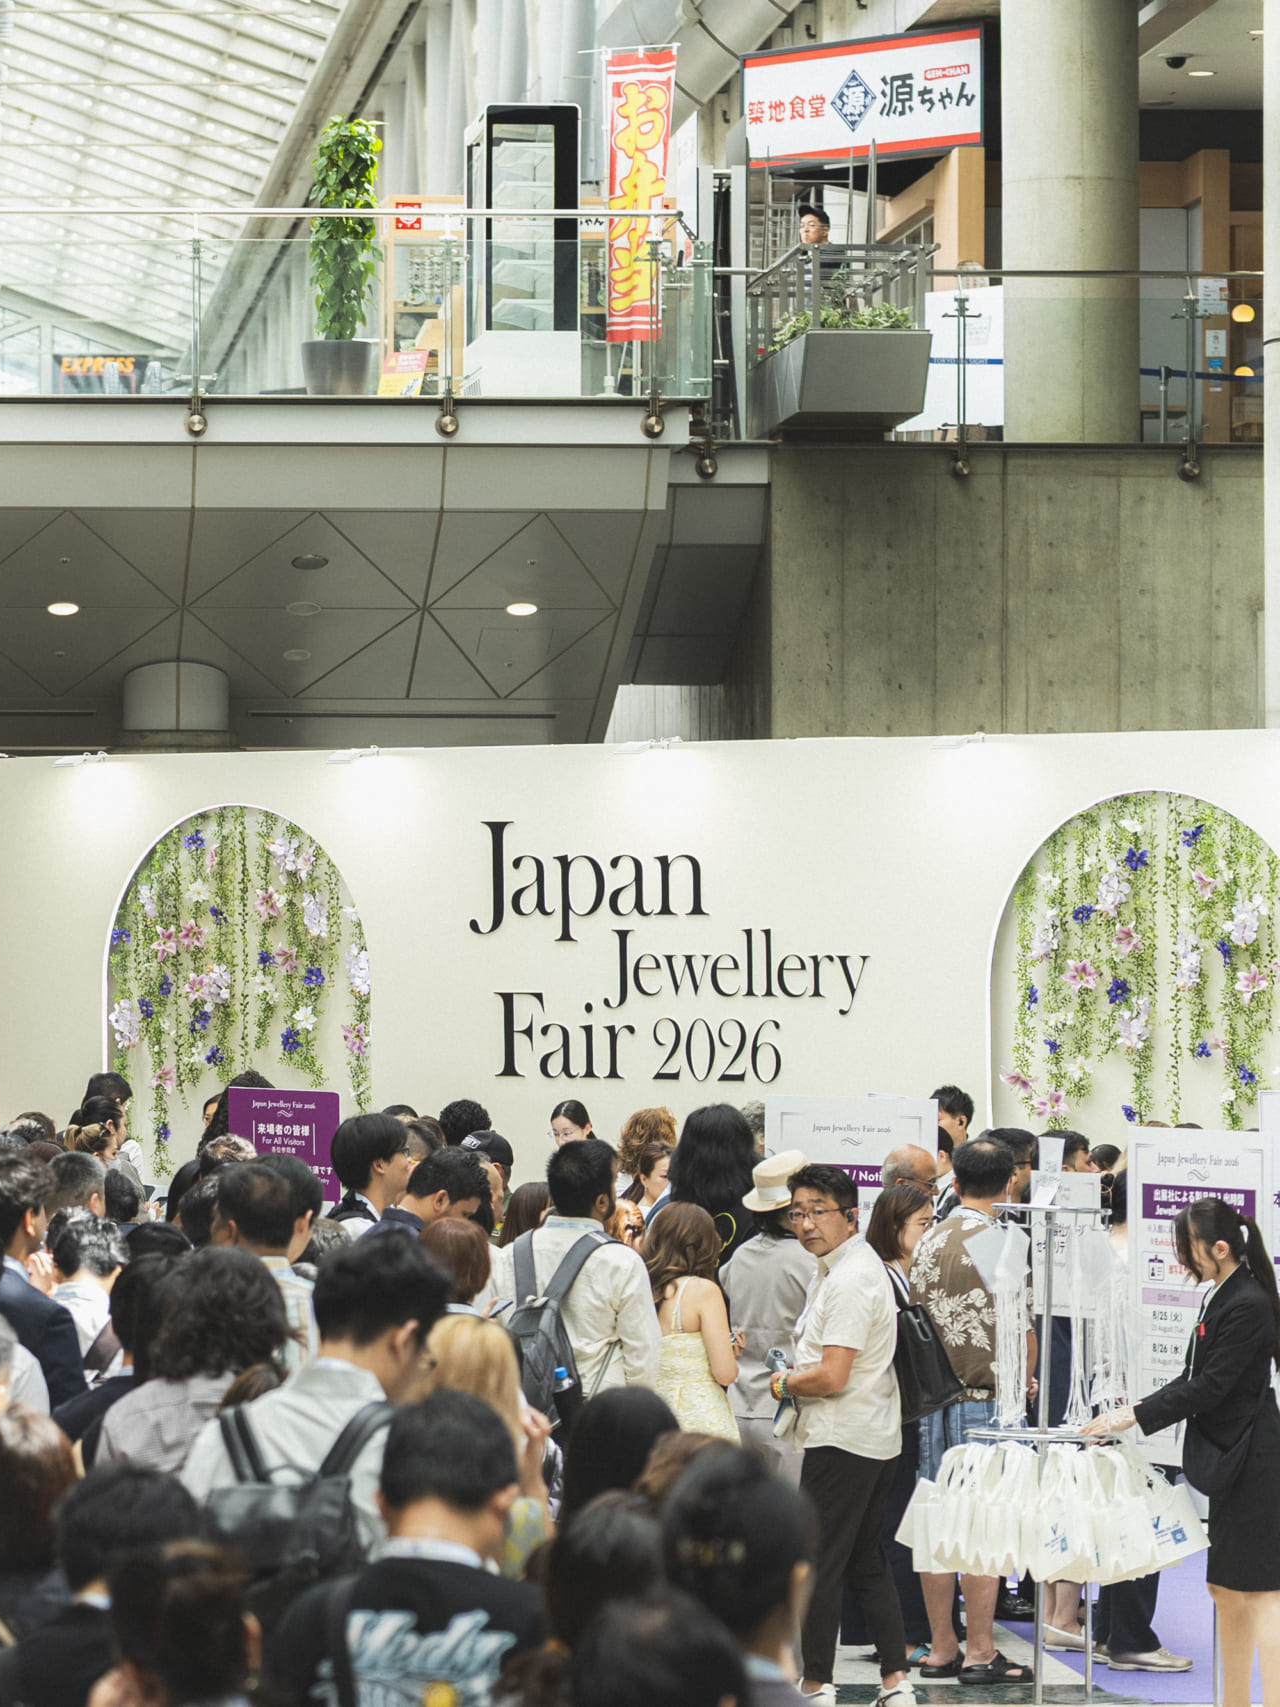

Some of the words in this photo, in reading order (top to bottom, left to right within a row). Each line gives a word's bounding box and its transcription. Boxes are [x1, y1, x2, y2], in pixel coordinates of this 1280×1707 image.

[925, 65, 969, 79] GEN-CHAN
[748, 94, 826, 125] 築地食堂
[879, 73, 976, 117] 源ちゃん
[609, 82, 668, 311] お弁当
[61, 356, 136, 373] EXPRSS
[469, 820, 710, 942] Japan
[603, 928, 870, 1016] Jewellery
[493, 991, 636, 1079] Fair
[652, 1017, 782, 1083] 2026
[252, 1099, 267, 1109] Japan
[267, 1100, 291, 1110] Jewellery
[292, 1101, 303, 1109] Fair
[257, 1123, 310, 1136] 来場者の皆様
[812, 1123, 831, 1134] Japan
[832, 1123, 861, 1134] Jewellery
[862, 1124, 875, 1133] Fair
[283, 1138, 306, 1146] Visitors
[1157, 1152, 1176, 1167] Japan
[1177, 1152, 1207, 1169] Jewellery
[1209, 1154, 1222, 1166] Fair
[1224, 1155, 1240, 1167] 2026
[859, 1170, 883, 1181] Noti
[1155, 1204, 1184, 1216] Jewelle
